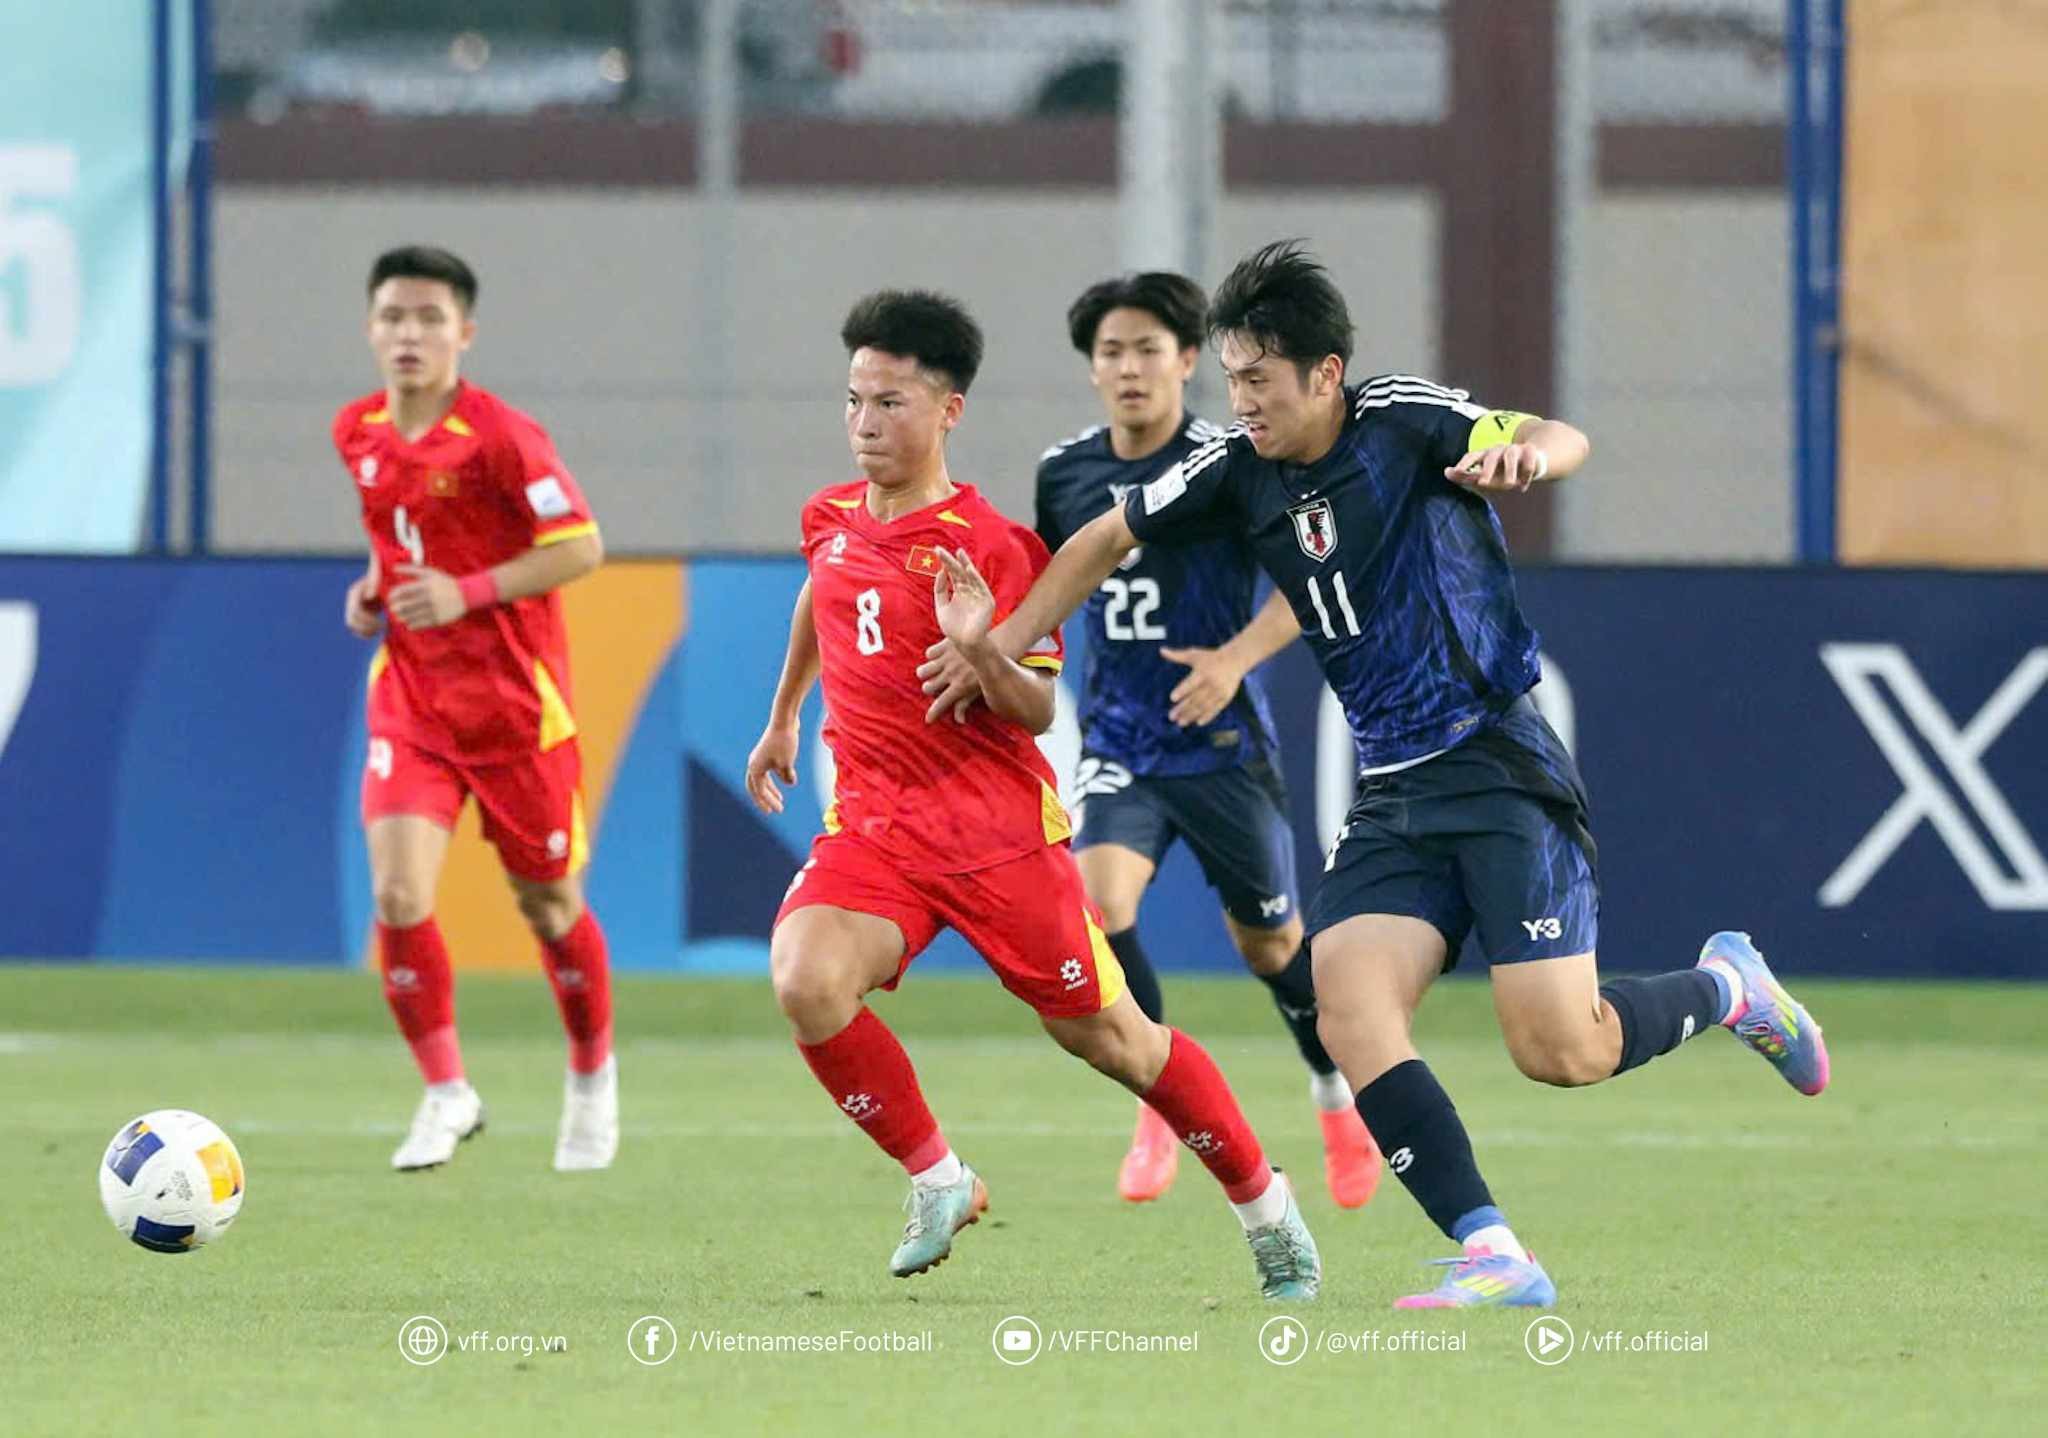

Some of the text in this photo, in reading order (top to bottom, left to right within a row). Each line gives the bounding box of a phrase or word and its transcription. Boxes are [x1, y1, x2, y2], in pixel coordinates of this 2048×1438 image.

[394, 505, 425, 566] 4
[857, 588, 884, 656] 8
[1101, 578, 1167, 640] 22
[1307, 571, 1361, 639] 11
[1521, 917, 1563, 942] Y-3
